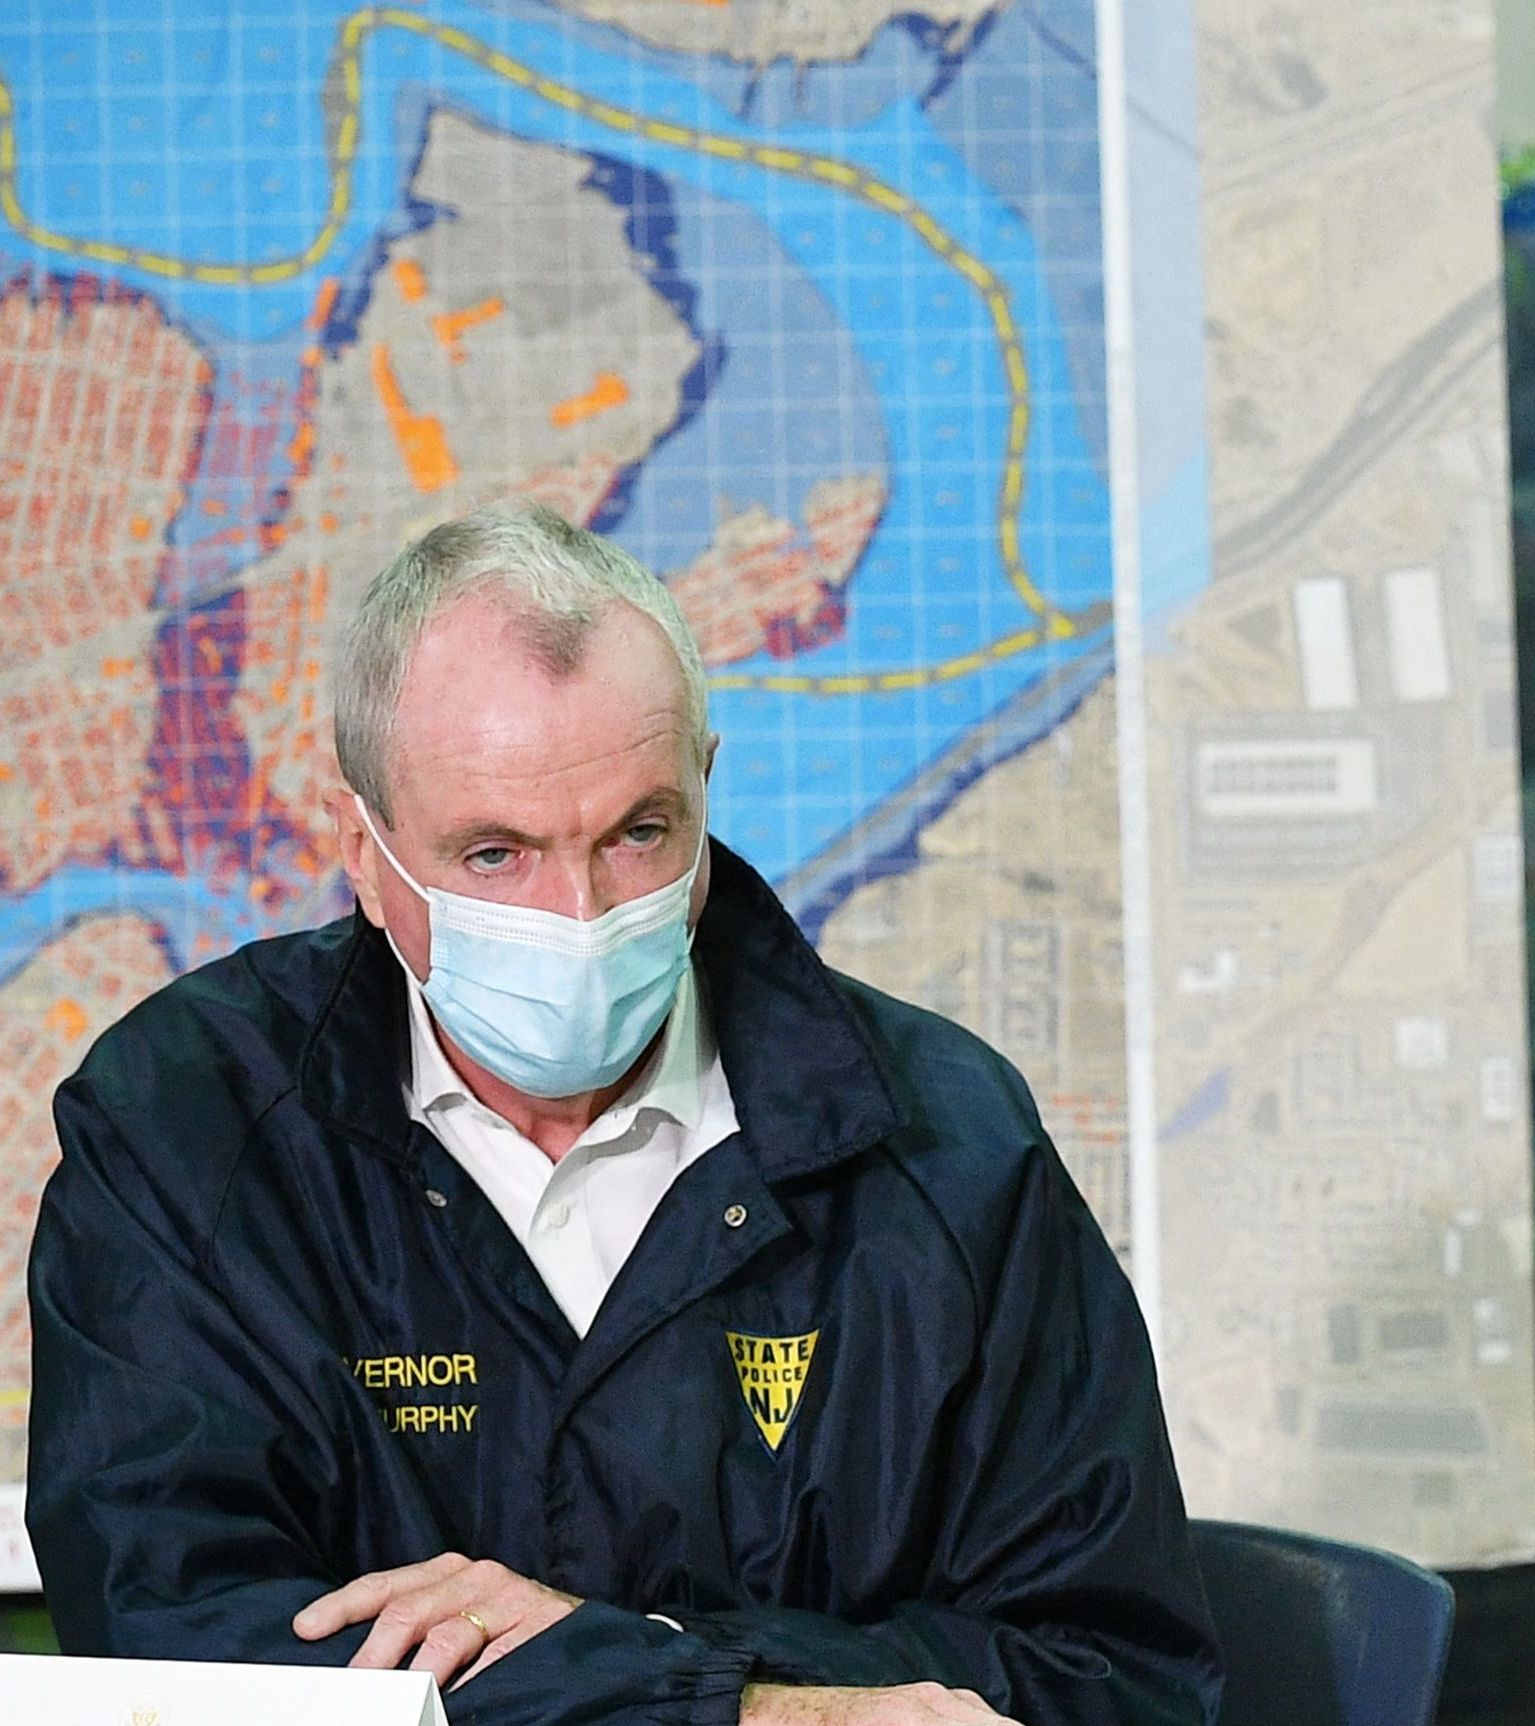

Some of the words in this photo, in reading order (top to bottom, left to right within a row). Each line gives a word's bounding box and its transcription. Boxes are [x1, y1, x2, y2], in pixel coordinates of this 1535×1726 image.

[735, 1338, 809, 1363] STATE
[742, 1366, 803, 1383] POLICE
[383, 1404, 478, 1433] URPHY
[750, 1386, 793, 1424] NJ
